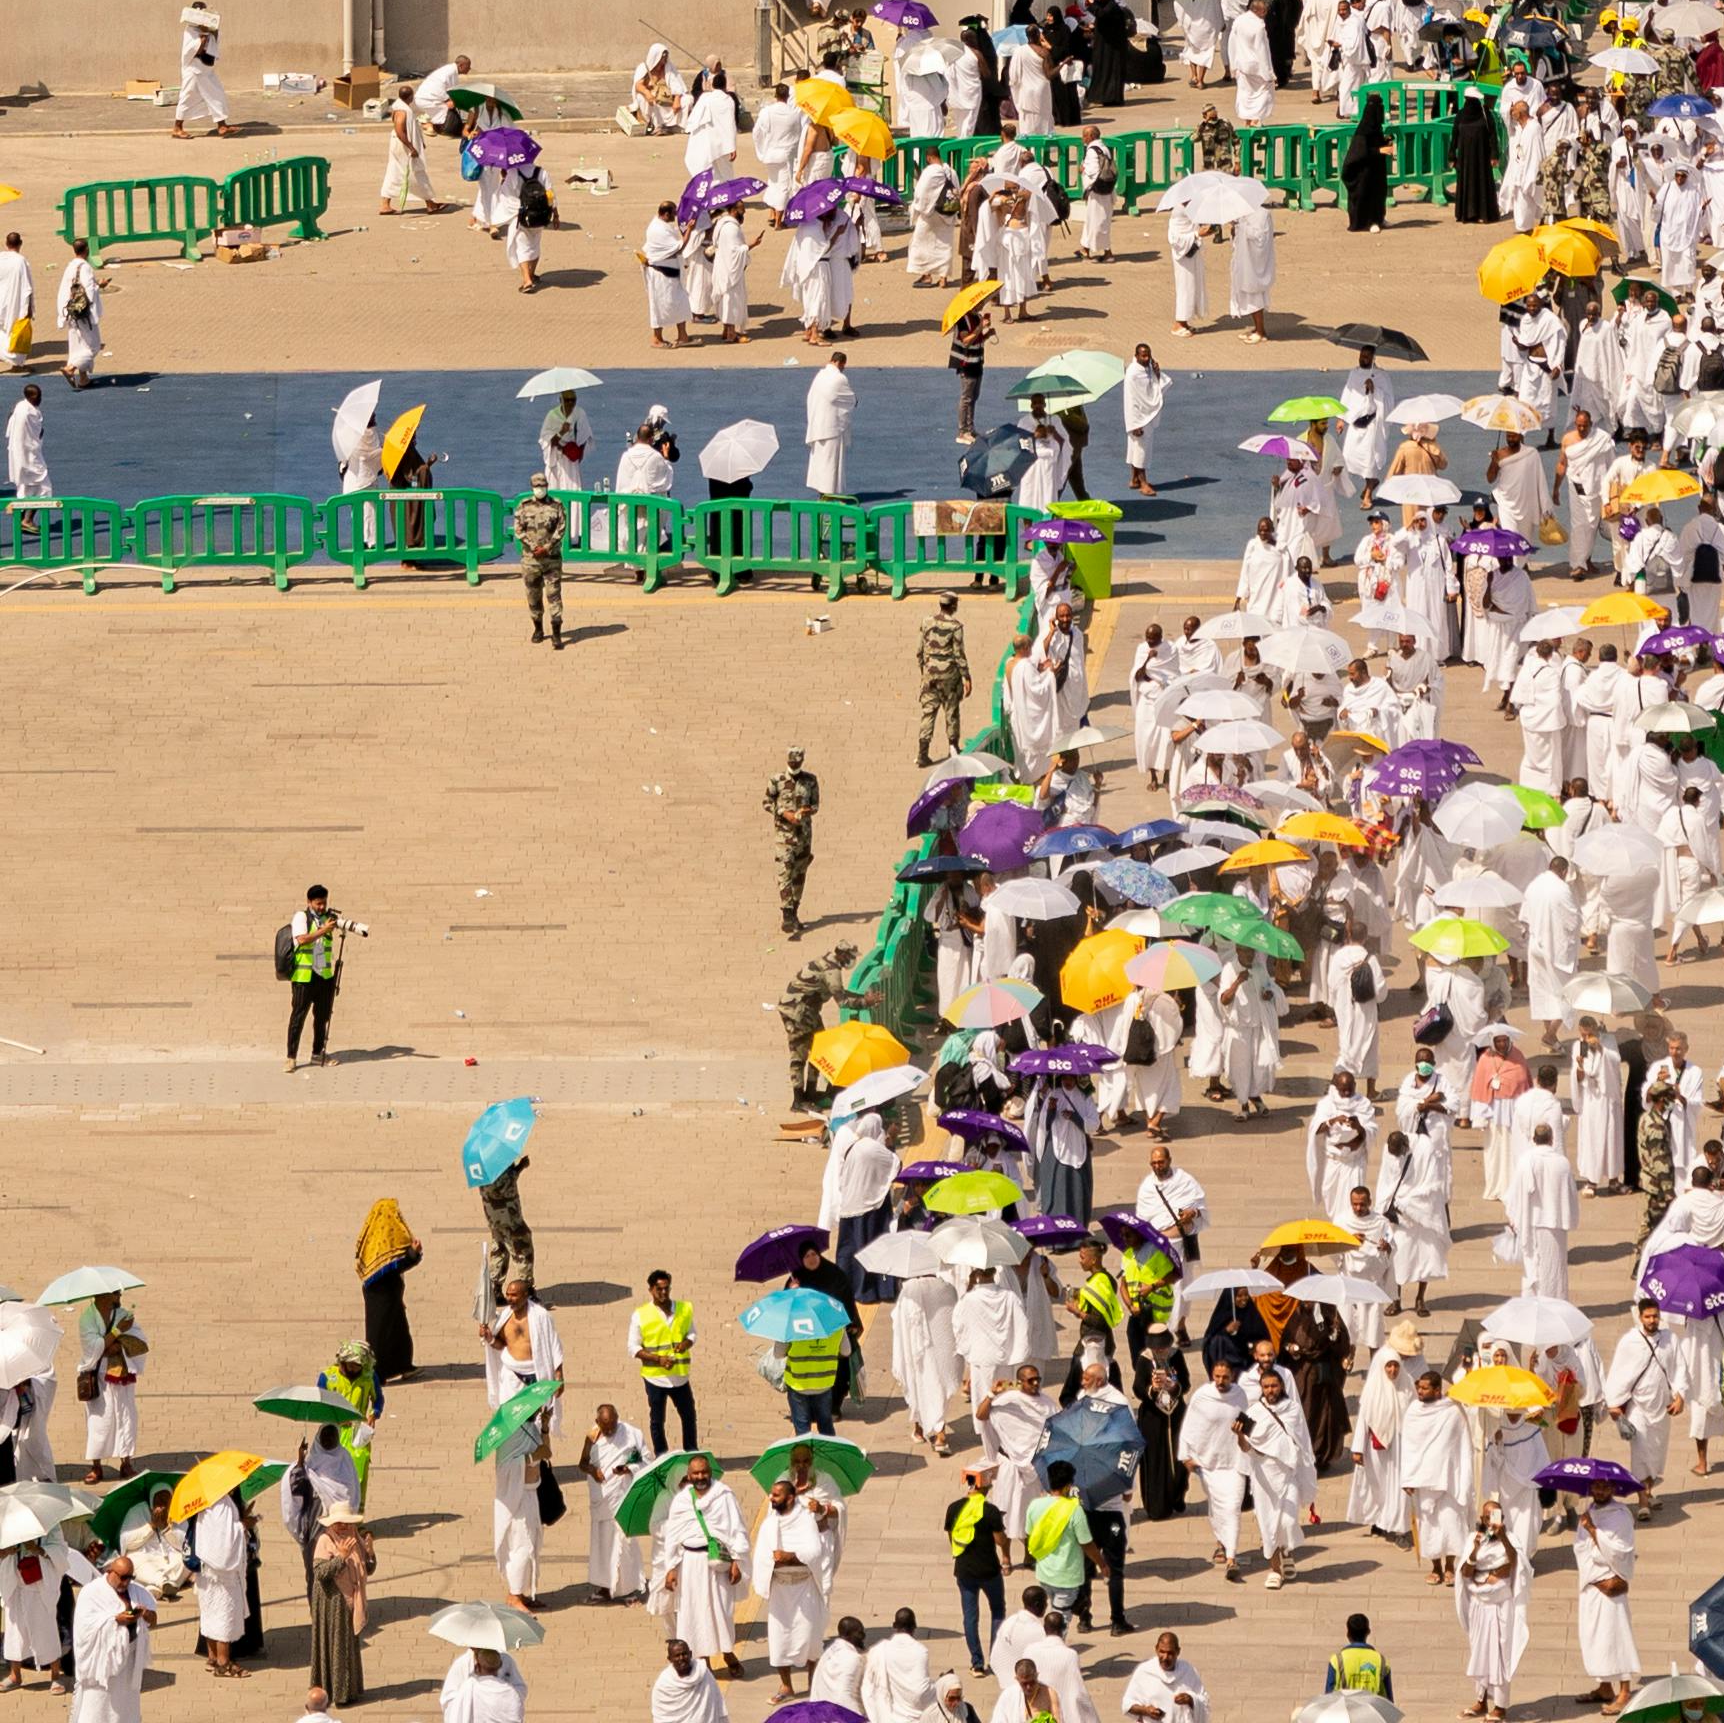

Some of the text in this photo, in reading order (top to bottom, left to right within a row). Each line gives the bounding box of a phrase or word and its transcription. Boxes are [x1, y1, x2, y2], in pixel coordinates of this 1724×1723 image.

[902, 15, 920, 26] stc
[1504, 283, 1529, 302] DHL
[1399, 767, 1422, 781] stc
[1093, 992, 1121, 1011] DHL
[1047, 1058, 1073, 1071] stc
[1648, 1277, 1667, 1301] stc
[1563, 1462, 1592, 1476] stc
[182, 1497, 205, 1517] DHL
